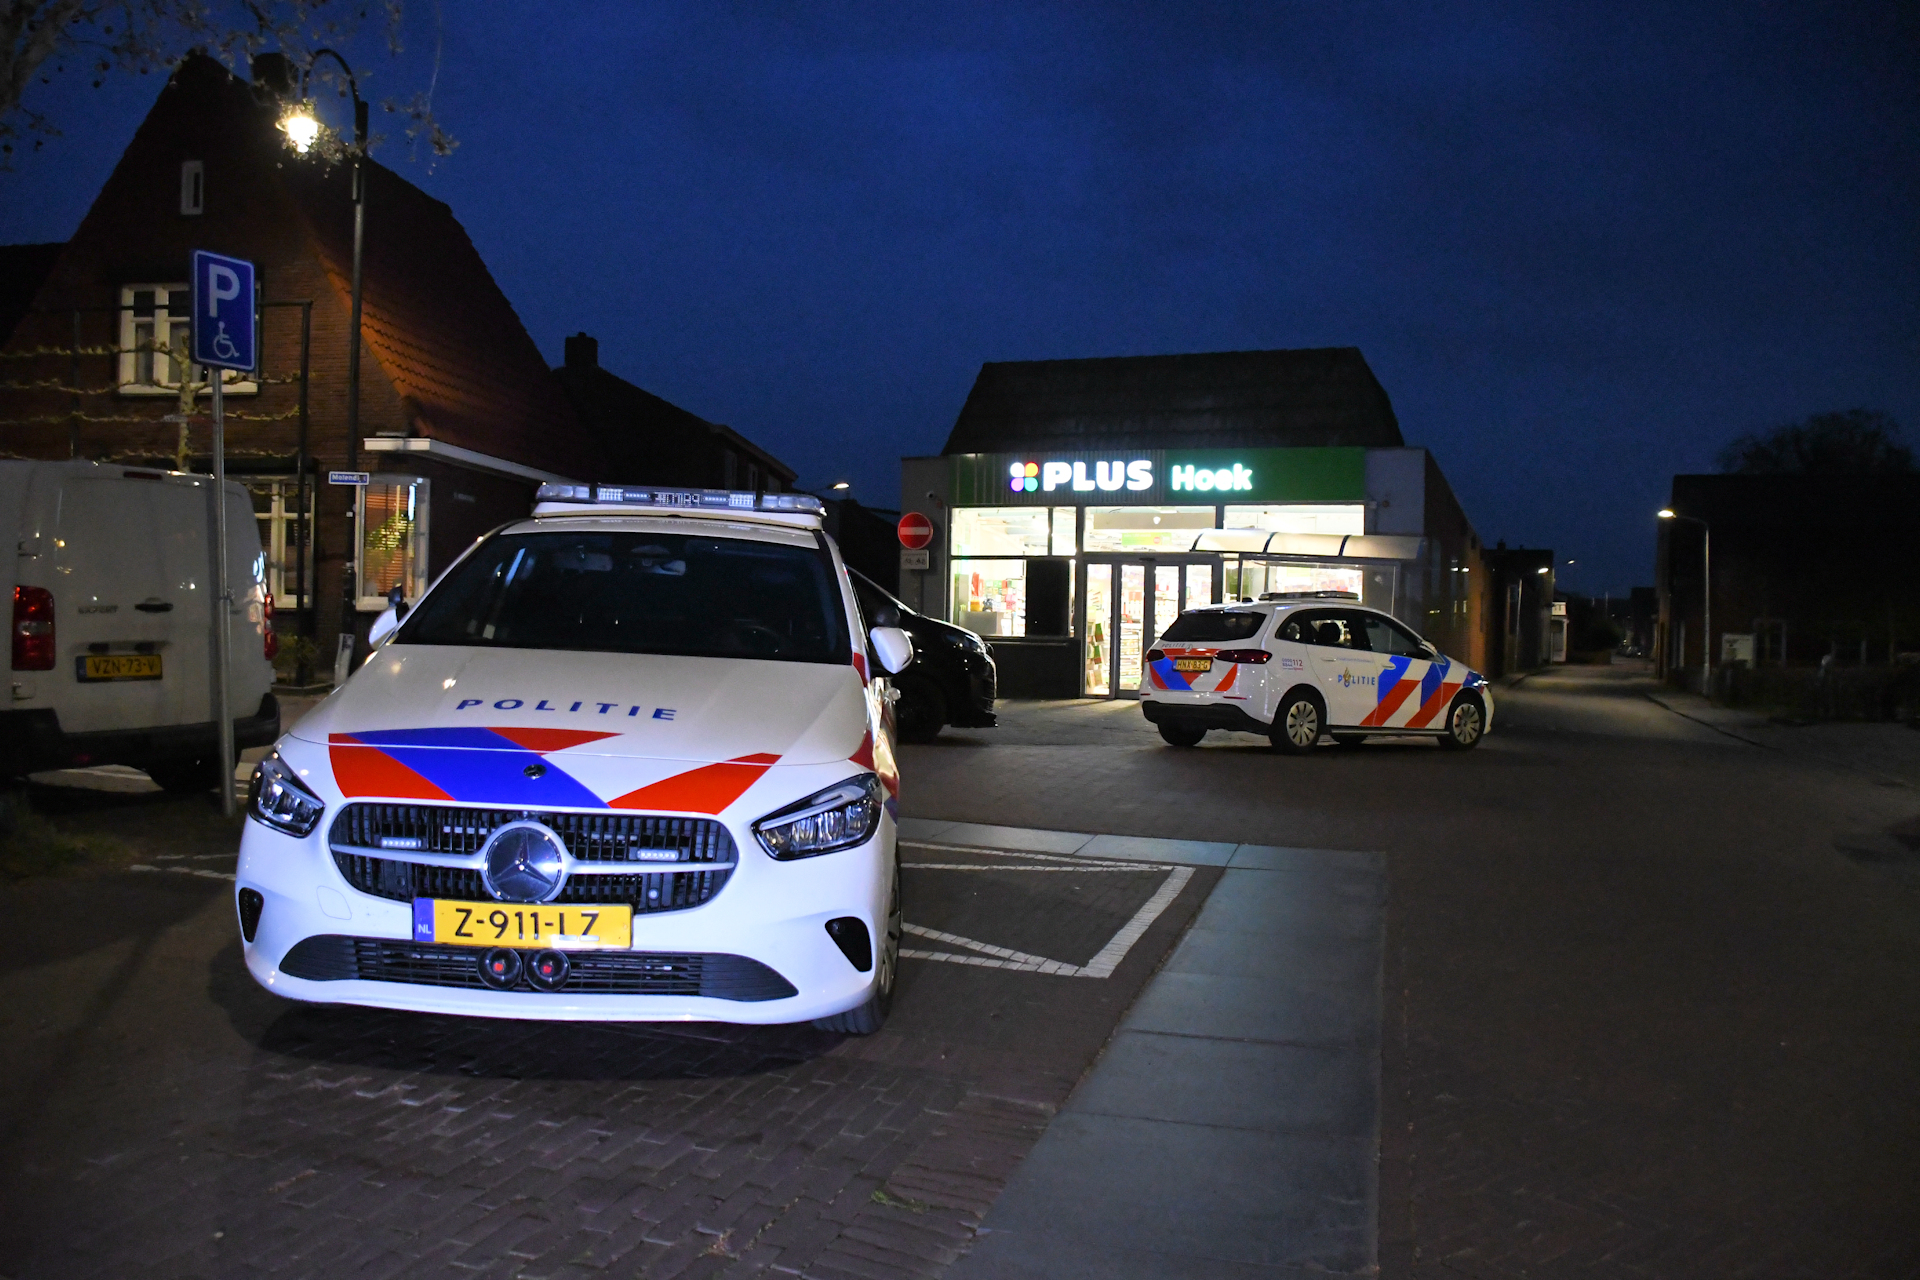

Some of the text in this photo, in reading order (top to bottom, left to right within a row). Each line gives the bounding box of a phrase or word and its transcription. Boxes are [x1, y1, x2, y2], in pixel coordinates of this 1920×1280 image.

[209, 263, 240, 318] P
[332, 473, 367, 482] Molend
[1043, 460, 1253, 492] PLUS Hoek
[93, 659, 156, 674] VZN-73-V
[1293, 659, 1303, 667] 112
[1338, 674, 1375, 687] POLITIE
[456, 699, 677, 720] POLITIE
[418, 924, 432, 935] NL
[455, 908, 600, 941] Z-911-LZ
